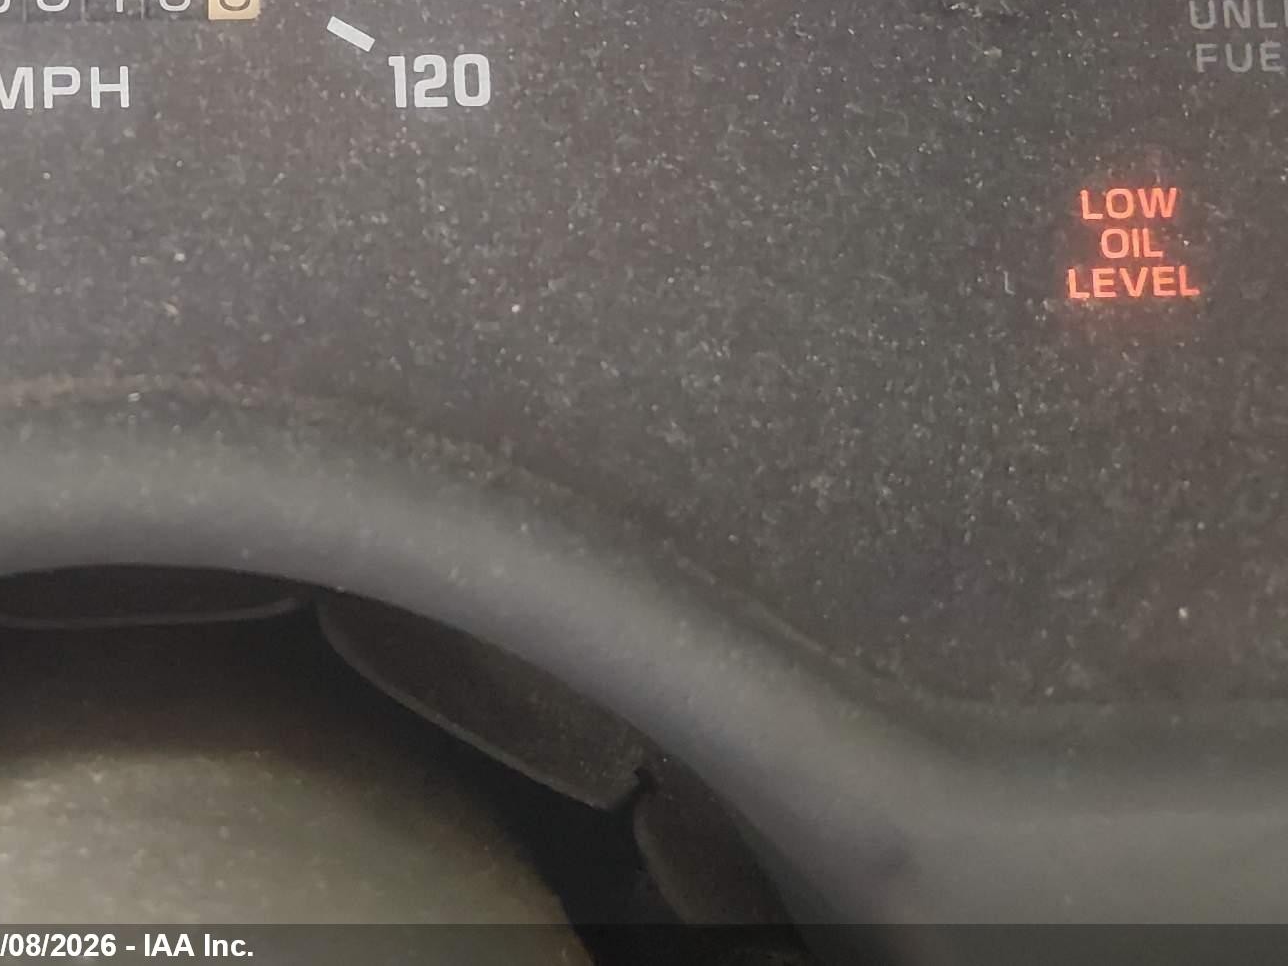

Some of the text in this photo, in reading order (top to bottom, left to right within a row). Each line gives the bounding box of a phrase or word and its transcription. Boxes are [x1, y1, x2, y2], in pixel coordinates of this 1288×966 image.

[388, 54, 491, 108] 120
[1080, 188, 1177, 220] LOW
[1100, 228, 1163, 259] OIL
[1067, 265, 1200, 299] LEVEL
